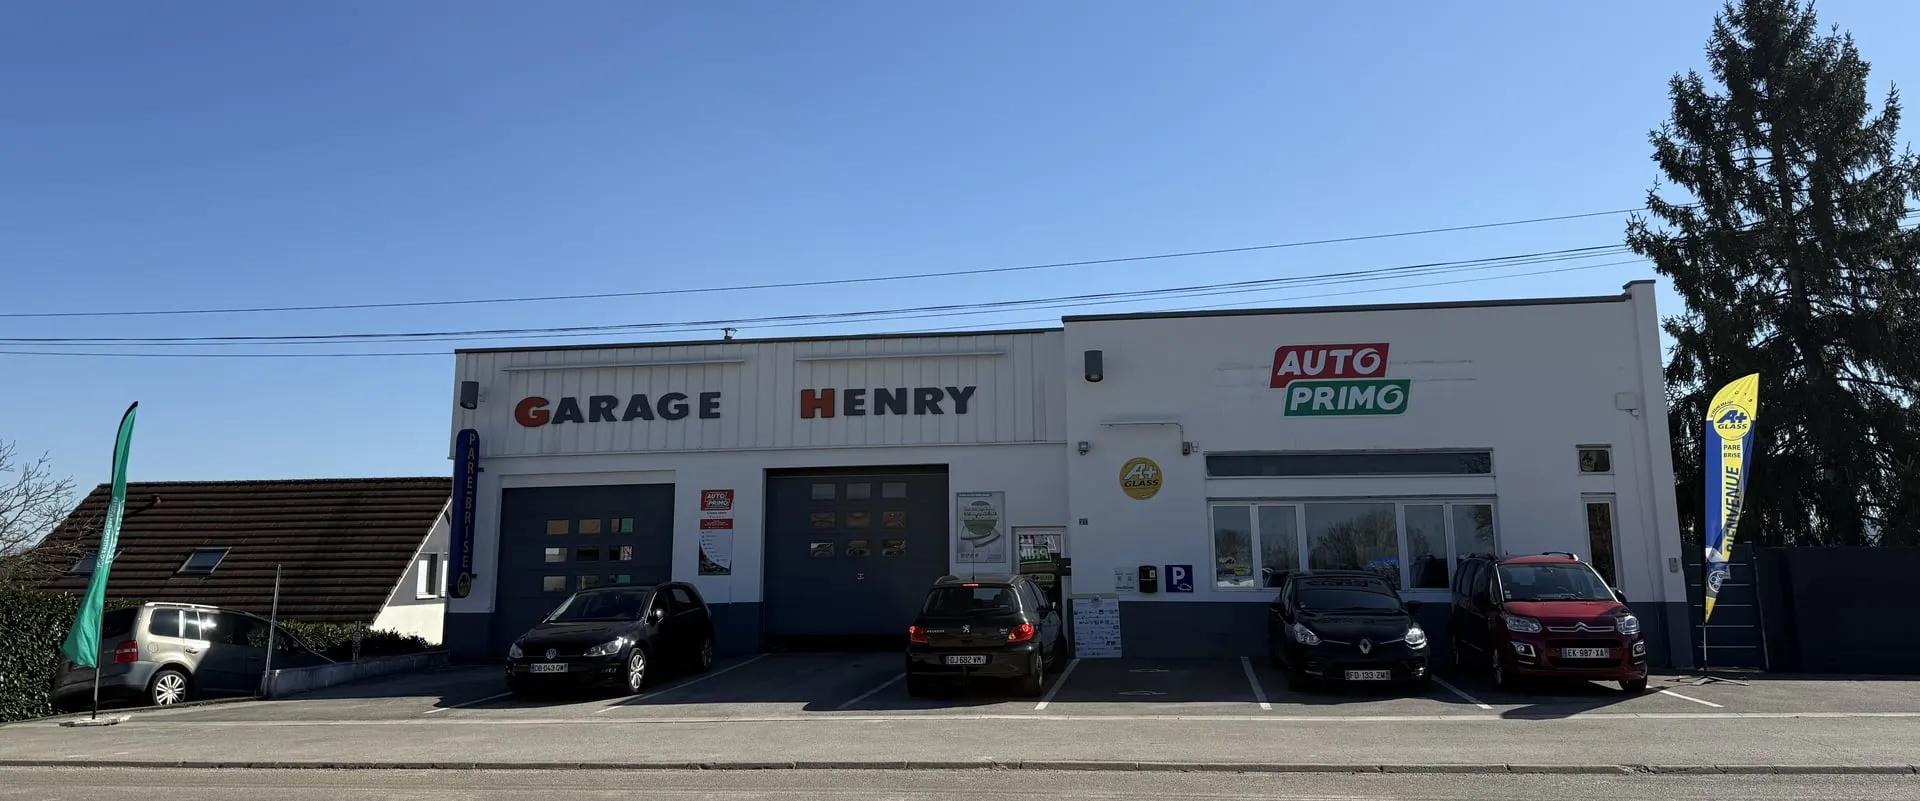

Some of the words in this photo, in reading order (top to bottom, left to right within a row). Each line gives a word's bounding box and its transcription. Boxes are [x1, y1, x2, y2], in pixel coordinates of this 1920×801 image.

[1277, 348, 1381, 376] AUTO
[514, 391, 721, 428] GARAGE
[800, 386, 977, 419] HENRY
[1290, 384, 1404, 411] PRIMO
[1124, 479, 1160, 488] GLASS
[1172, 566, 1186, 585] P
